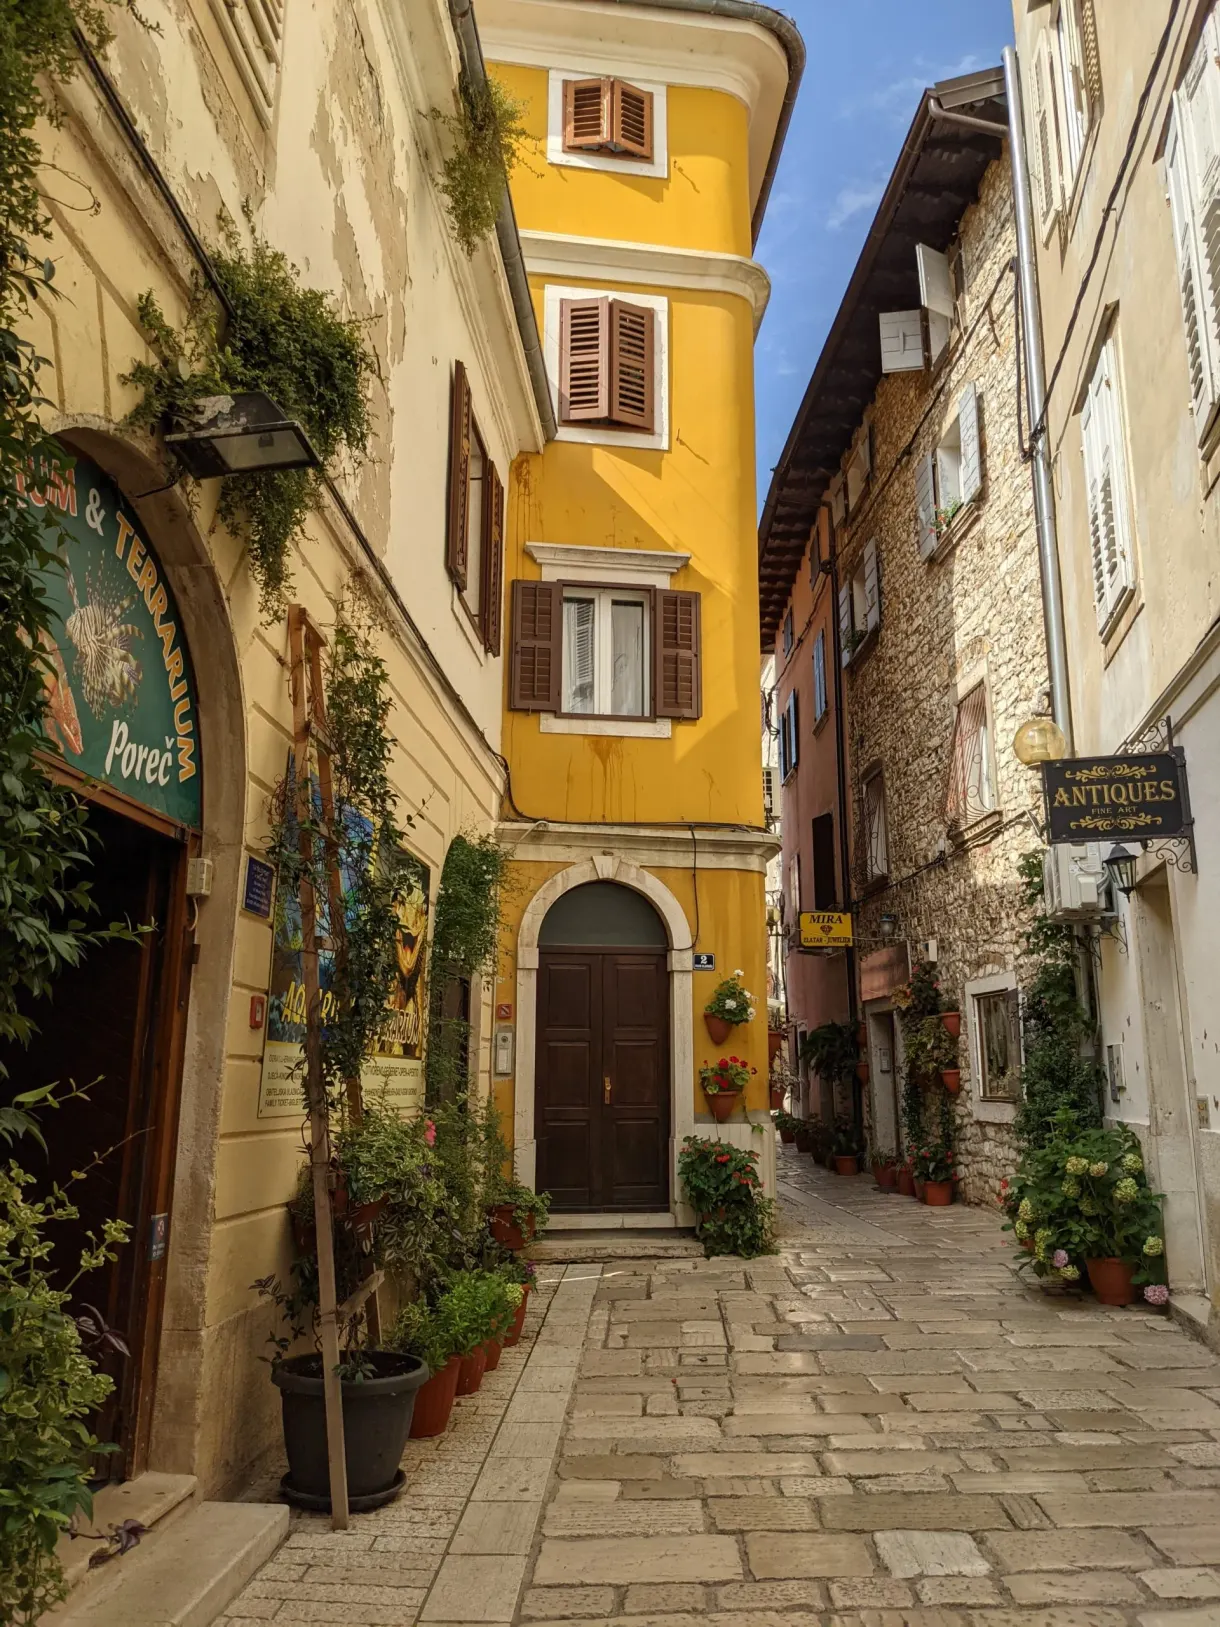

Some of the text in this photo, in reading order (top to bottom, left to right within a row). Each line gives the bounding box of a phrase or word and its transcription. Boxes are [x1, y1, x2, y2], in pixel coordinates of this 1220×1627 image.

[85, 487, 106, 537] &
[114, 510, 196, 783] TERRARIUM
[104, 719, 175, 787] Poreč
[1052, 780, 1176, 807] ANTIQUES
[1091, 805, 1138, 815] FINE ART
[808, 914, 843, 924] MIRA
[700, 955, 708, 965] 2
